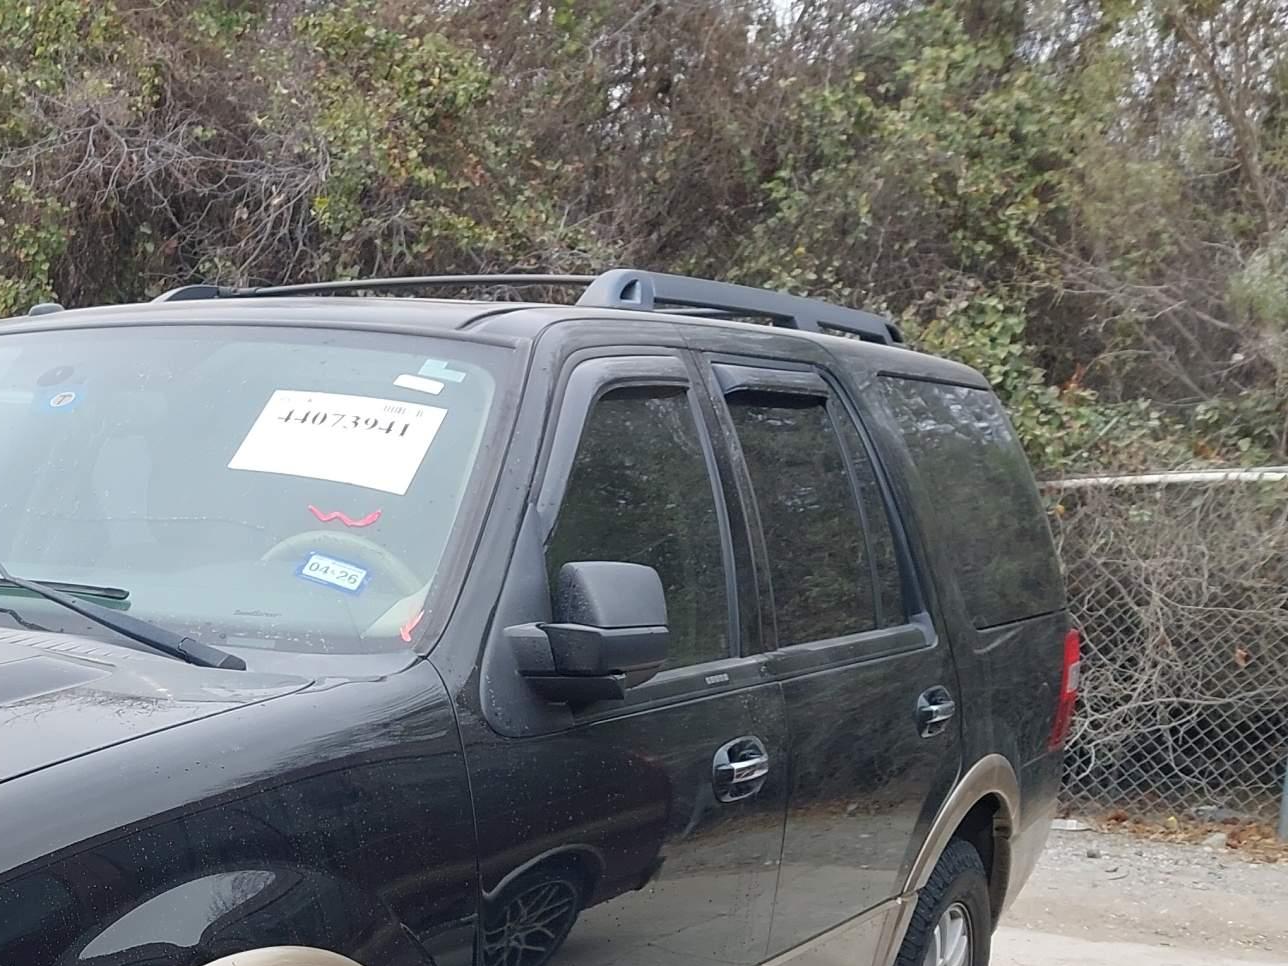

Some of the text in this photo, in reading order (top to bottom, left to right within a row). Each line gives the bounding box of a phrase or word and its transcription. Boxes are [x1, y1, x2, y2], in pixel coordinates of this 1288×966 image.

[277, 408, 411, 437] 44073941
[308, 561, 359, 585] 04 26
